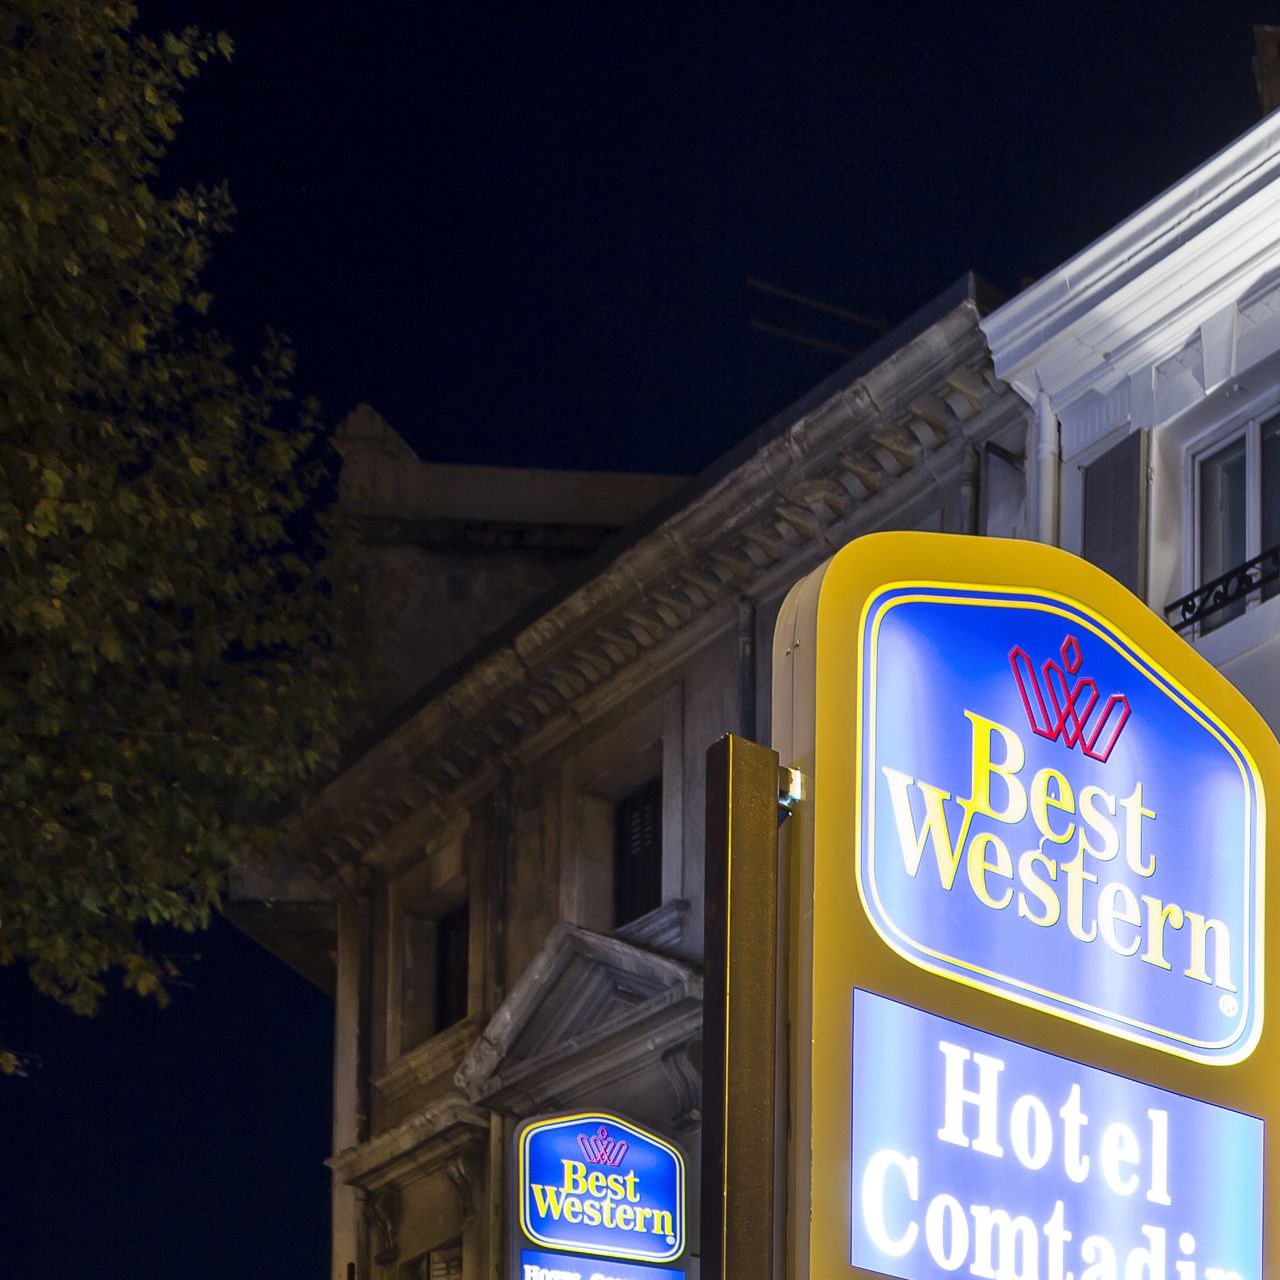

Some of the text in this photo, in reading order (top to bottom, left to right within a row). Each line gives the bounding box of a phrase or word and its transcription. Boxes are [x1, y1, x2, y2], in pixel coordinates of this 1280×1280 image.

[963, 709, 1156, 879] Best
[881, 764, 1237, 994] Western
[561, 1159, 640, 1203] Best
[937, 1040, 1172, 1207] Hotel
[531, 1184, 675, 1236] Western
